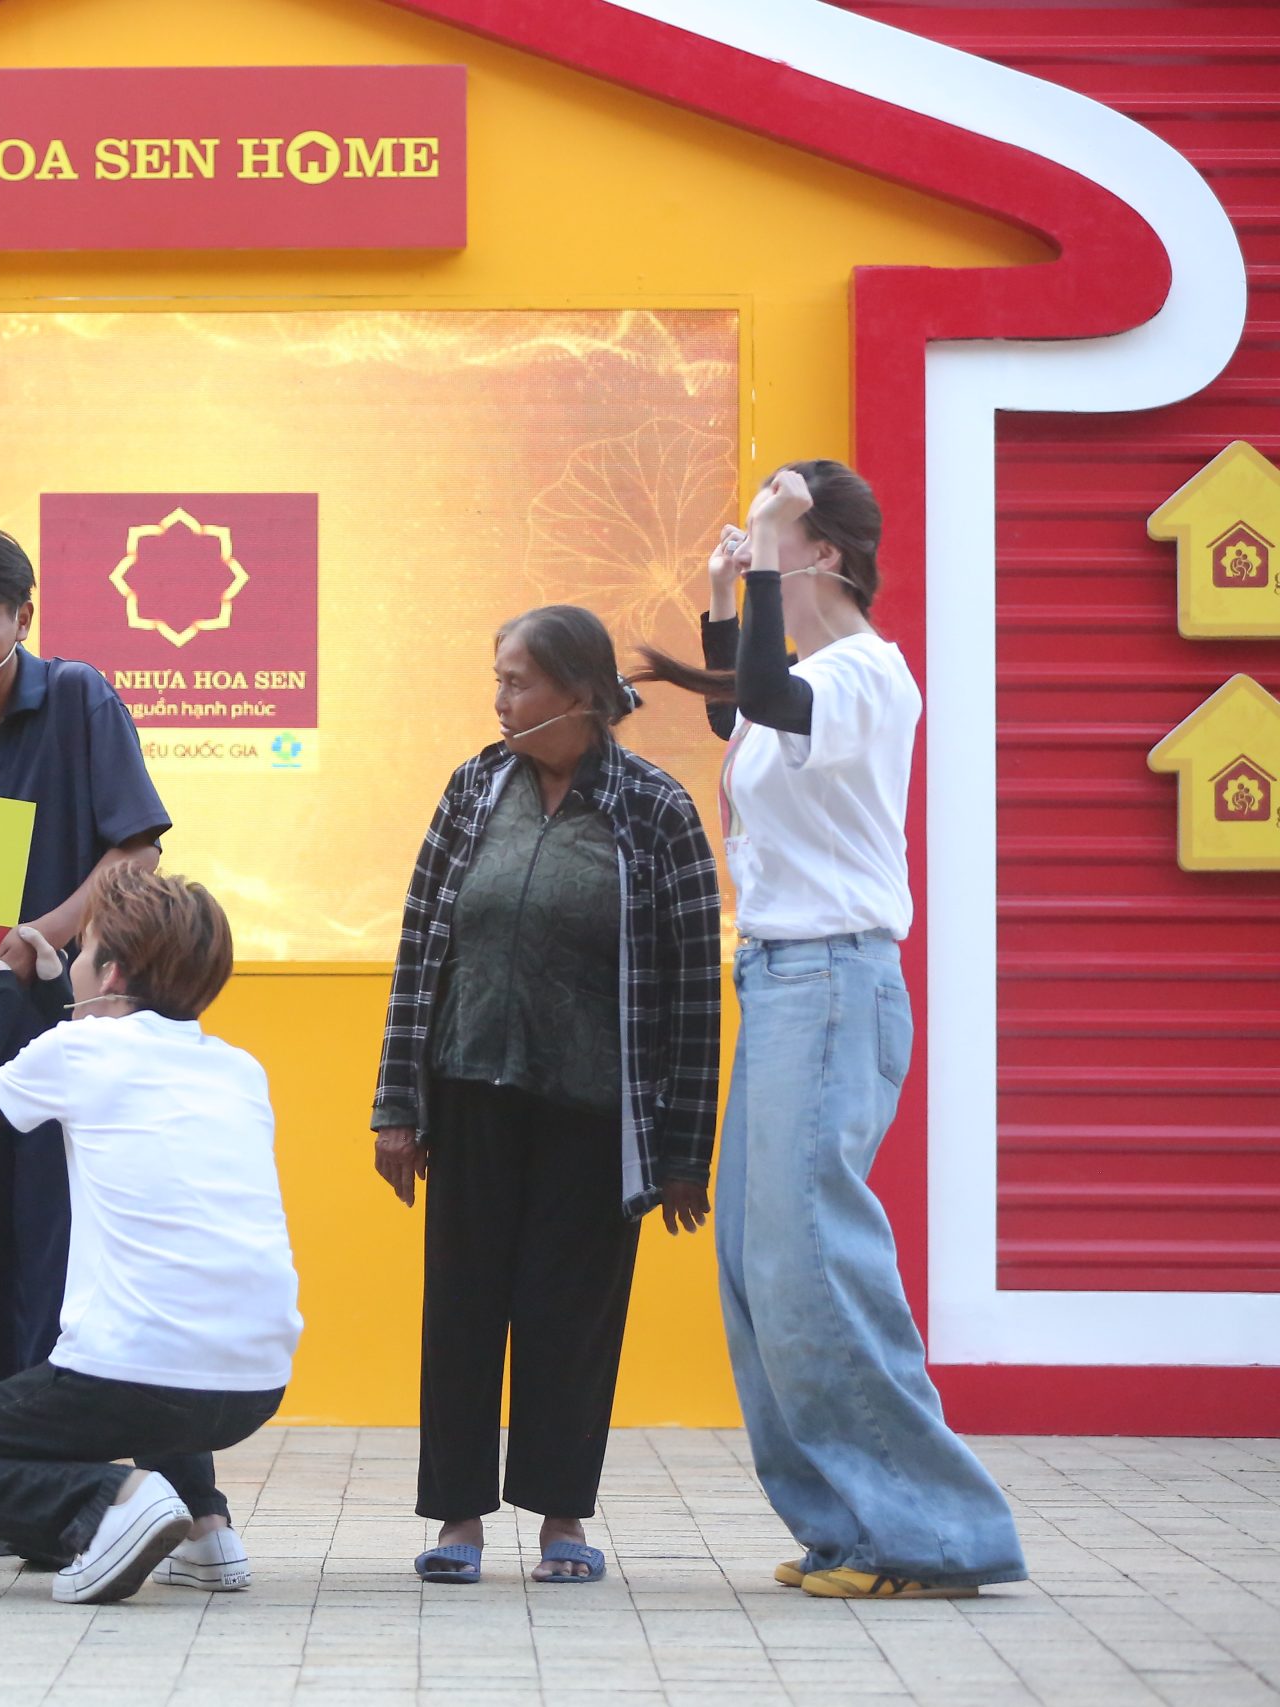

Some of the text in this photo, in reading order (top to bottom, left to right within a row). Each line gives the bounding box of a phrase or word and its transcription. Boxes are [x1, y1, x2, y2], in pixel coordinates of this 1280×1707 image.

[94, 137, 220, 180] SEN
[236, 130, 439, 184] HOME
[113, 669, 187, 695] NHỰA
[193, 670, 249, 690] HOA
[254, 670, 307, 690] SEN
[181, 700, 227, 719] hạnh
[231, 700, 276, 720] phúc
[173, 740, 224, 759] QUỐC
[229, 743, 259, 758] GIA
